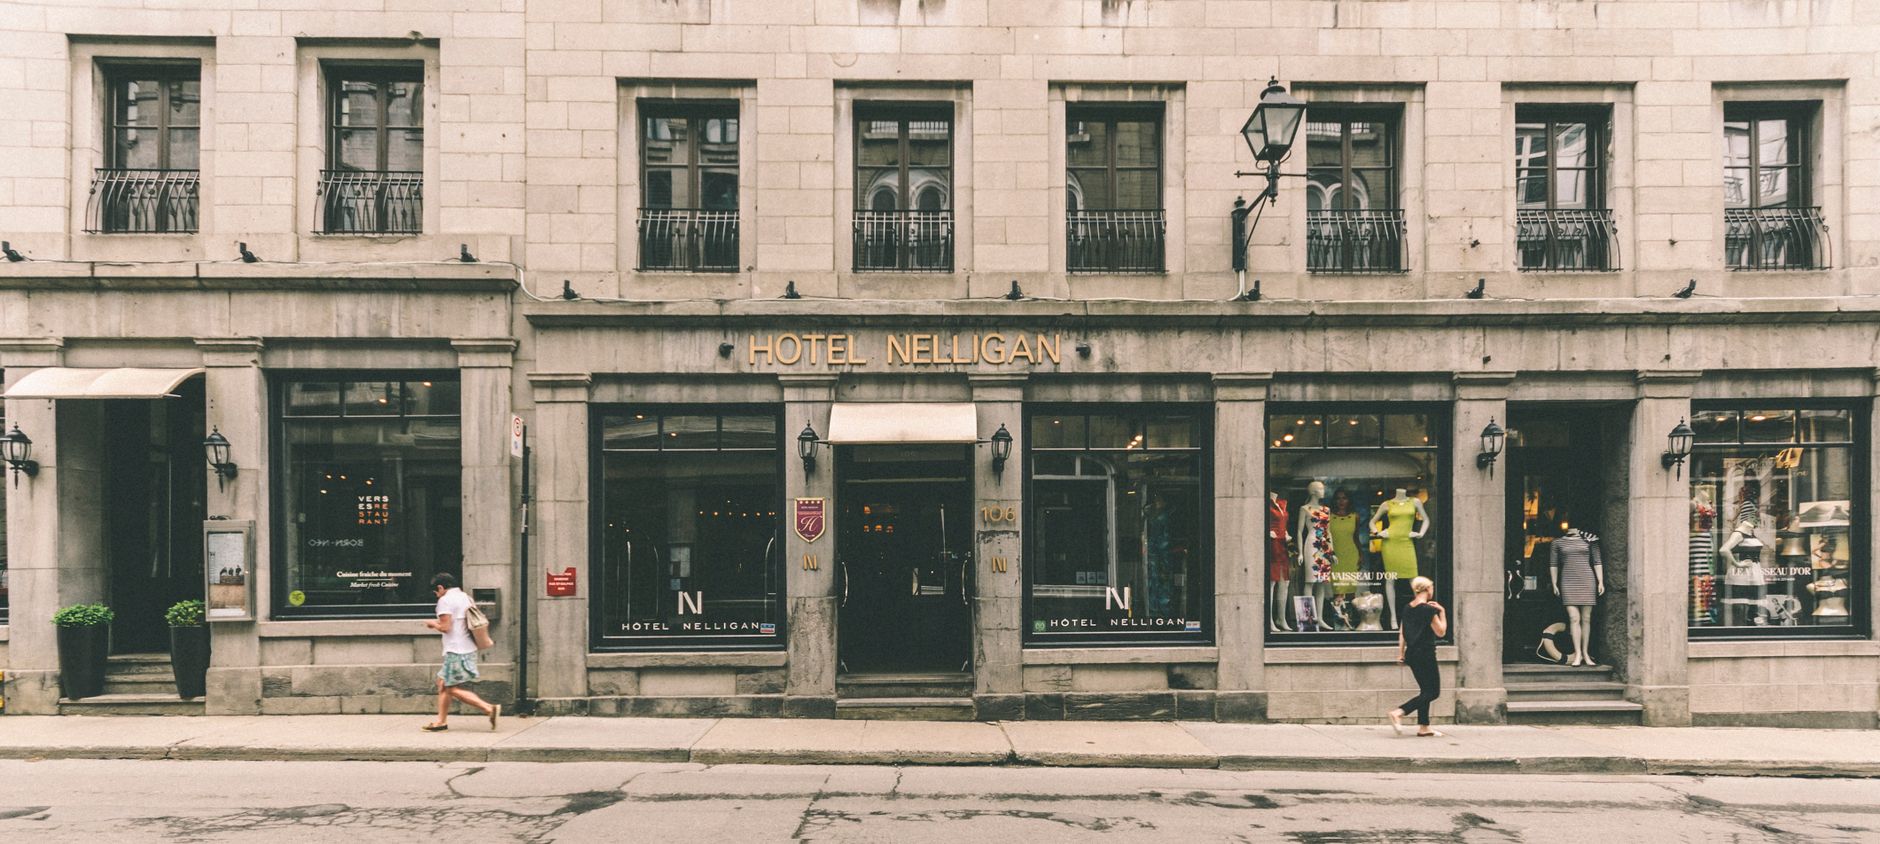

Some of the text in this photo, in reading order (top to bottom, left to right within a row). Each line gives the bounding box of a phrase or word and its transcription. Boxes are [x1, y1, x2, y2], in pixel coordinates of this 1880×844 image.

[749, 332, 1061, 366] HOTEL NELLIGAN
[980, 505, 1016, 523] 106
[1317, 572, 1398, 580] LE VAISSEAU D'OR
[1732, 567, 1812, 576] LE VSSEAU D'OR
[683, 622, 759, 630] NELLIGAN
[1110, 617, 1185, 626] NELLIGAN
